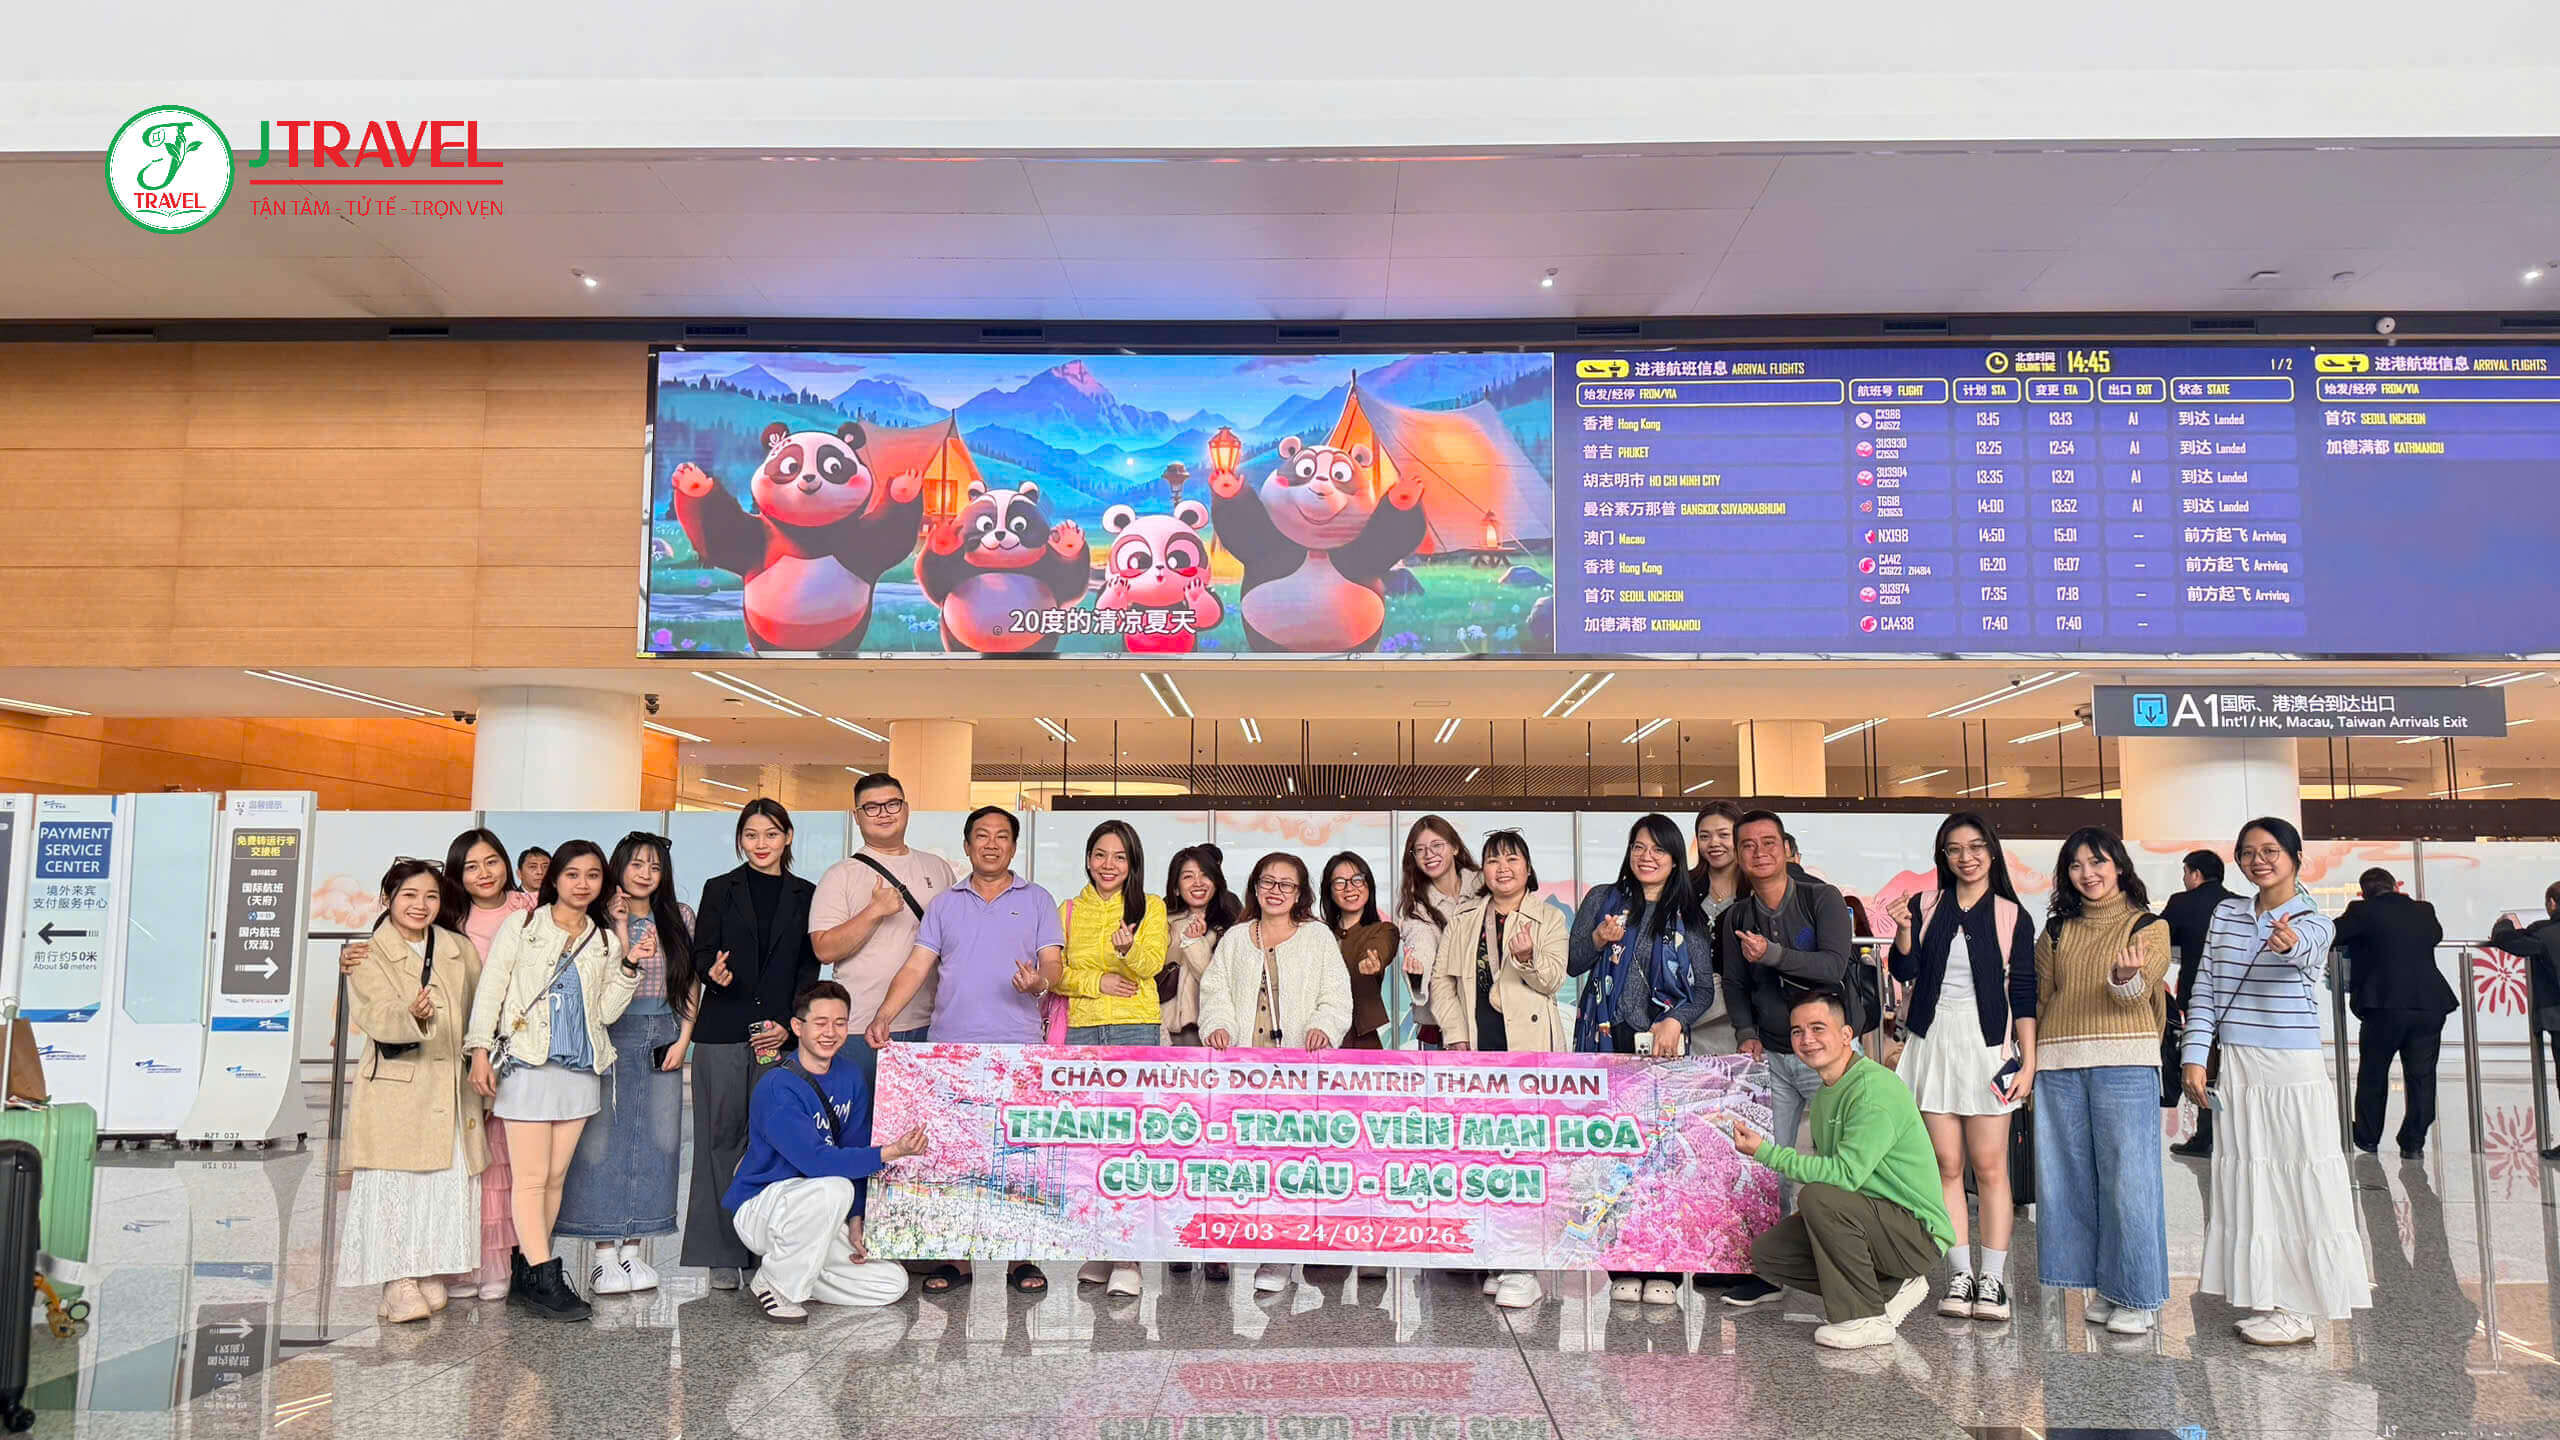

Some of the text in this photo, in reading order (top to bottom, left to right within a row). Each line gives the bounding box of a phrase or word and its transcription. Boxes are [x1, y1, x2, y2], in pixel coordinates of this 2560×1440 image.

[2015, 352, 2056, 362] 北京时间
[2068, 350, 2111, 373] 14:45
[2375, 356, 2470, 372] 进港航班信息
[1635, 360, 1728, 377] 进港航班信息
[1732, 362, 1805, 375] ARRIVAL FLIGHTS
[2473, 359, 2547, 371] ARRIVAL FLIGHTS
[1584, 388, 1678, 401] 始发/经停 FROM/VIA
[1857, 385, 1923, 397] 航班号 FLIGHT
[1963, 384, 2006, 397] 计划 STA
[2035, 384, 2078, 396] 变更 ETA
[2108, 384, 2153, 396] 出口 EXIT
[2178, 383, 2230, 396] 状态 STATE
[2324, 383, 2420, 396] 始发/经停 FROM/VIA
[1583, 416, 1661, 432] 香港 Hong Kong
[1976, 412, 2000, 426] 13:15
[2049, 412, 2073, 426] 13:13
[2178, 411, 2245, 426] 到达 Landed
[2324, 410, 2426, 426] 首尔 SEOUL INCHEON
[1583, 445, 1649, 459] 普吉 PHUKET
[1976, 441, 2002, 455] 13:25
[2049, 441, 2075, 455] 12:54
[2180, 440, 2246, 455] 到达 Landed
[2326, 440, 2445, 455] 加德满都 KATHMANDU
[1583, 473, 1720, 488] 胡志明市 HO CHI MINH CITY
[1976, 470, 2003, 484] 13:35
[2051, 470, 2075, 484] 13:21
[2181, 469, 2248, 484] 到达 Landed
[1583, 501, 1786, 517] 曼谷素万那普 BANGKOK SUVARNABHUMI
[1977, 499, 2004, 513] 14:00
[2051, 499, 2077, 513] 13:52
[2183, 498, 2250, 514] 到达 Landed
[1583, 530, 1646, 546] 澳门 Macau
[1878, 528, 1909, 543] NX198
[1978, 528, 2005, 543] 14:50
[2054, 528, 2077, 543] 15:01
[2184, 527, 2287, 545] 前方起飞 Arriving
[1583, 559, 1663, 576] 香港 Hong Kong
[1980, 557, 2007, 572] 16:20
[2053, 557, 2080, 572] 16:07
[2185, 557, 2289, 574] 前方起飞 Arriving
[1583, 588, 1684, 603] 首尔 SEOUL INCHEON
[1981, 586, 2007, 601] 17:35
[2056, 586, 2079, 601] 17:18
[2186, 586, 2290, 603] 前方起飞 Arriving
[1010, 608, 1196, 634] 20度的清凉夏天
[1583, 617, 1701, 632] 加德满都 KATHMANDU
[1880, 616, 1914, 631] CA438
[1982, 616, 2008, 630] 17:40
[2056, 616, 2082, 630] 17:40
[2172, 693, 2219, 728] A1
[2221, 695, 2395, 713] 国际、港澳台到达出口
[2221, 716, 2248, 728] Int'l
[2259, 716, 2282, 730] HK,
[2287, 716, 2334, 730] Macau,
[2337, 716, 2386, 728] Taiwan
[2390, 716, 2439, 728] Arrivals
[2443, 716, 2468, 728] Exit
[40, 827, 111, 840] PAYMENT
[45, 844, 103, 856] SERVICE
[45, 861, 100, 873] CENTER
[47, 885, 96, 896] 境外来宾
[242, 882, 283, 893] 国际航班
[33, 898, 108, 909] 支付服务中心
[239, 927, 280, 937] 国内航班
[34, 952, 97, 963] 前行约50米
[33, 963, 97, 971] About 50 meters
[1051, 1062, 1127, 1088] CHÀO
[1228, 1064, 1307, 1090] ĐOÀN
[1318, 1070, 1426, 1093] FAMTRIP
[1434, 1072, 1510, 1095] THAM
[1519, 1074, 1599, 1097] QUAN
[1008, 1104, 1640, 1154] THÀNH ĐÔ TRANG VIÊN MẠN HOA
[1187, 1161, 1266, 1200] TRẠI
[1279, 1159, 1350, 1195] CÂU
[1390, 1166, 1453, 1204] LẠC
[1465, 1167, 1542, 1199] SƠN
[1198, 1222, 1456, 1246] 19/03 24/03/2026
